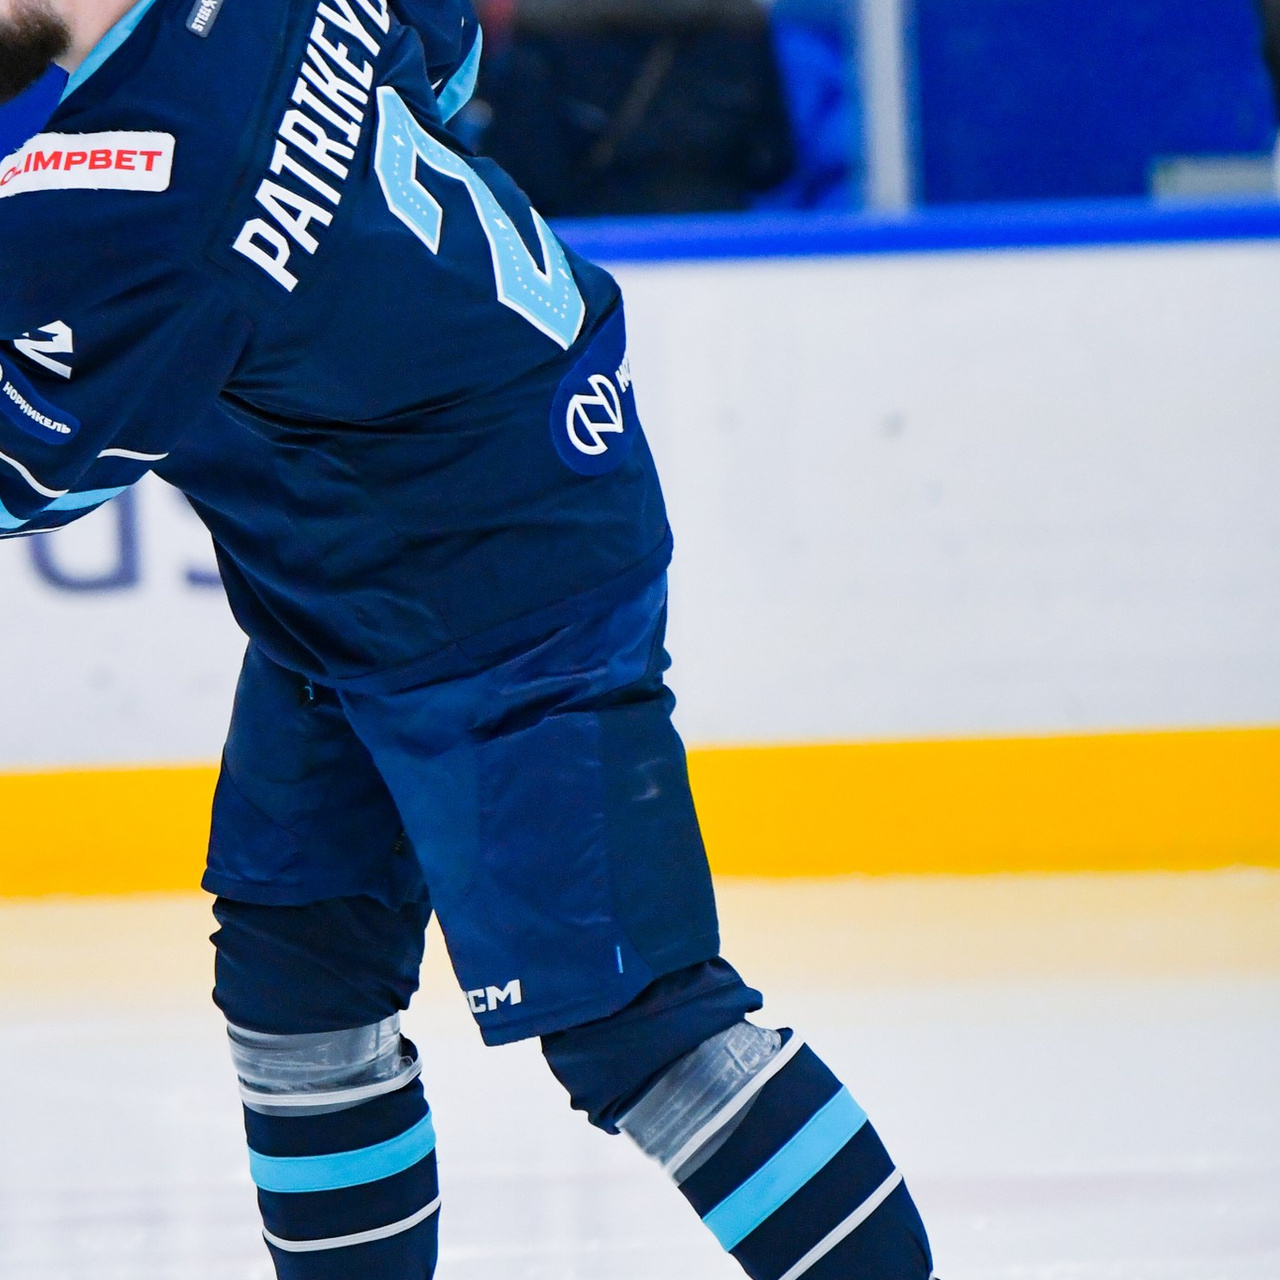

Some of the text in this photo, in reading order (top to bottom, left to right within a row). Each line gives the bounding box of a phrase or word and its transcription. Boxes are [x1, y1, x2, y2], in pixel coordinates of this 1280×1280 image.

[191, 4, 212, 32] STEEL
[375, 85, 586, 351] 2
[12, 319, 74, 380] 2
[2, 381, 72, 434] НОРНИКЕЛЬ
[462, 978, 522, 1014] CM
